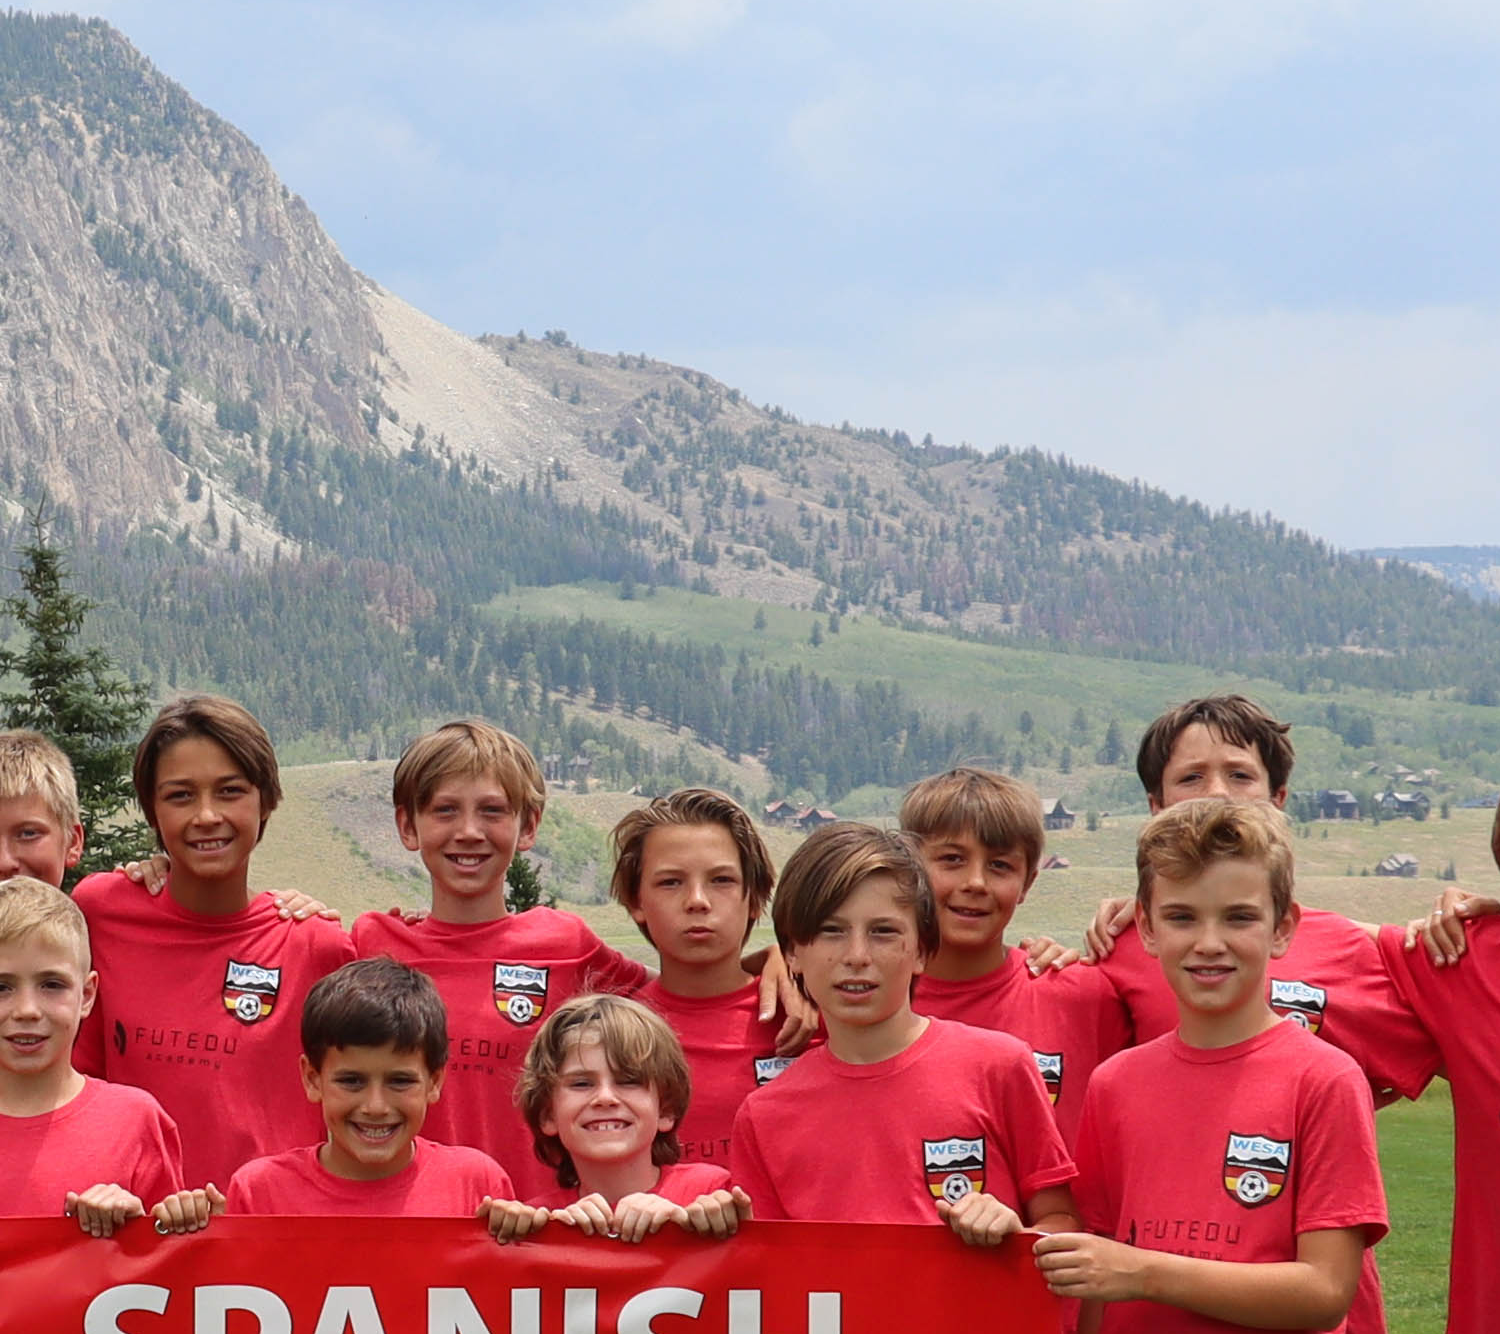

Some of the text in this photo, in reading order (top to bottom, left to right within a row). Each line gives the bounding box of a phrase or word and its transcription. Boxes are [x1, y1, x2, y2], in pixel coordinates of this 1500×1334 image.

[231, 964, 276, 981] WESA
[499, 967, 544, 982] WESA
[1275, 983, 1322, 1000] WESA
[135, 1027, 238, 1056] FUTEDU
[928, 1142, 981, 1155] WESA
[1232, 1138, 1286, 1156] WESA
[1143, 1218, 1241, 1244] FUTEDU
